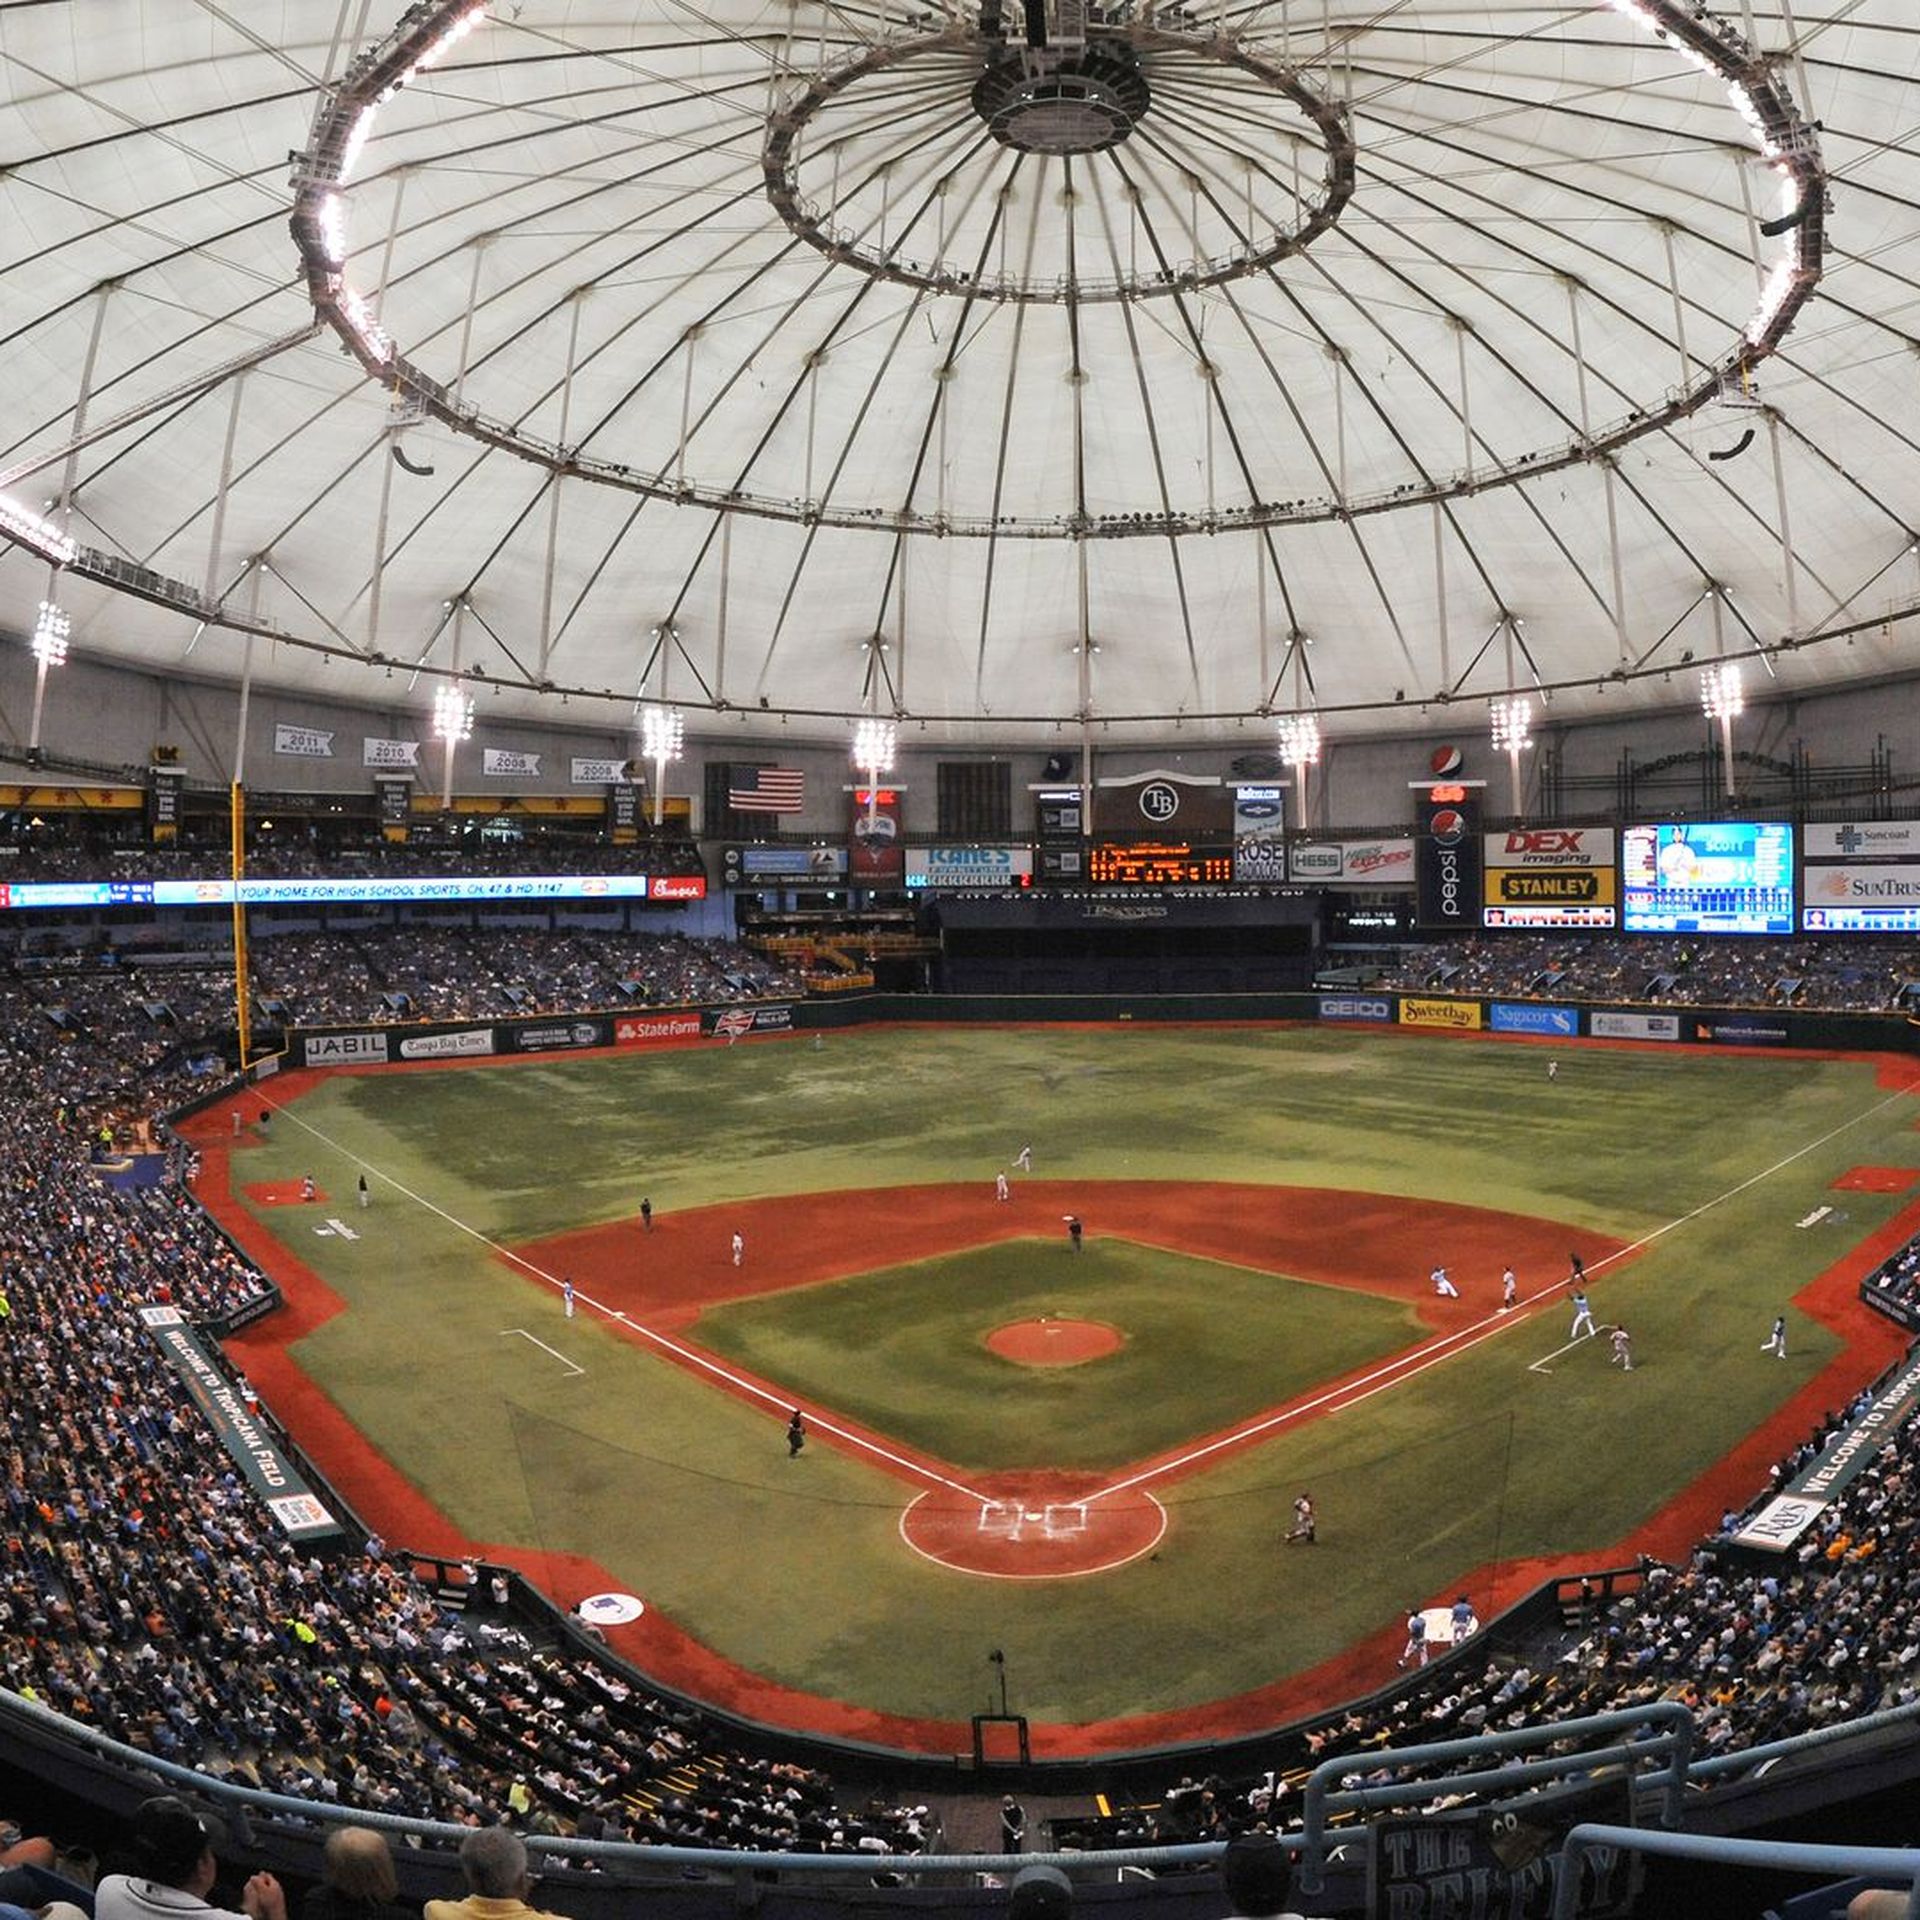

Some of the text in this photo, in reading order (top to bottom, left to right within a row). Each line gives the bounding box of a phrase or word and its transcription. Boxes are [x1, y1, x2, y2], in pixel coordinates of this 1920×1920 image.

[289, 734, 318, 747] 2011
[375, 746, 405, 757] 2010
[583, 766, 612, 775] 2008
[1147, 789, 1173, 815] TB
[1505, 831, 1584, 853] DEX
[1864, 830, 1910, 840] Suncoast
[1236, 839, 1283, 861] ROSE
[1704, 840, 1745, 852] SCOTT
[1295, 854, 1339, 867] HESS
[1522, 853, 1592, 865] imaging
[241, 887, 272, 898] YOUR
[274, 887, 308, 898] HOME
[311, 887, 335, 897] FOR
[337, 886, 366, 897] HIGH
[370, 885, 415, 897] SCHOOL
[419, 884, 462, 895] SPORTS
[489, 884, 503, 893] 47
[515, 883, 533, 894] HD
[536, 882, 563, 893] 1147
[1437, 850, 1460, 916] pepsi
[1508, 879, 1591, 895] STANLEY
[1173, 890, 1261, 898] WELCOMES
[1320, 1001, 1388, 1017] GEICO
[1405, 1000, 1474, 1023] Sweetbay
[1498, 1007, 1548, 1027] Sagicor
[308, 1037, 385, 1056] JABIL
[407, 1034, 486, 1054] Tampa Bay Times
[164, 1330, 210, 1378] WELCOME
[202, 1373, 220, 1388] TO
[212, 1387, 260, 1448] TROPICANA
[252, 1449, 286, 1487] FIELD
[1802, 1429, 1871, 1493] WELCOME
[1863, 1413, 1885, 1429] TO
[1384, 1828, 1473, 1879] THE
